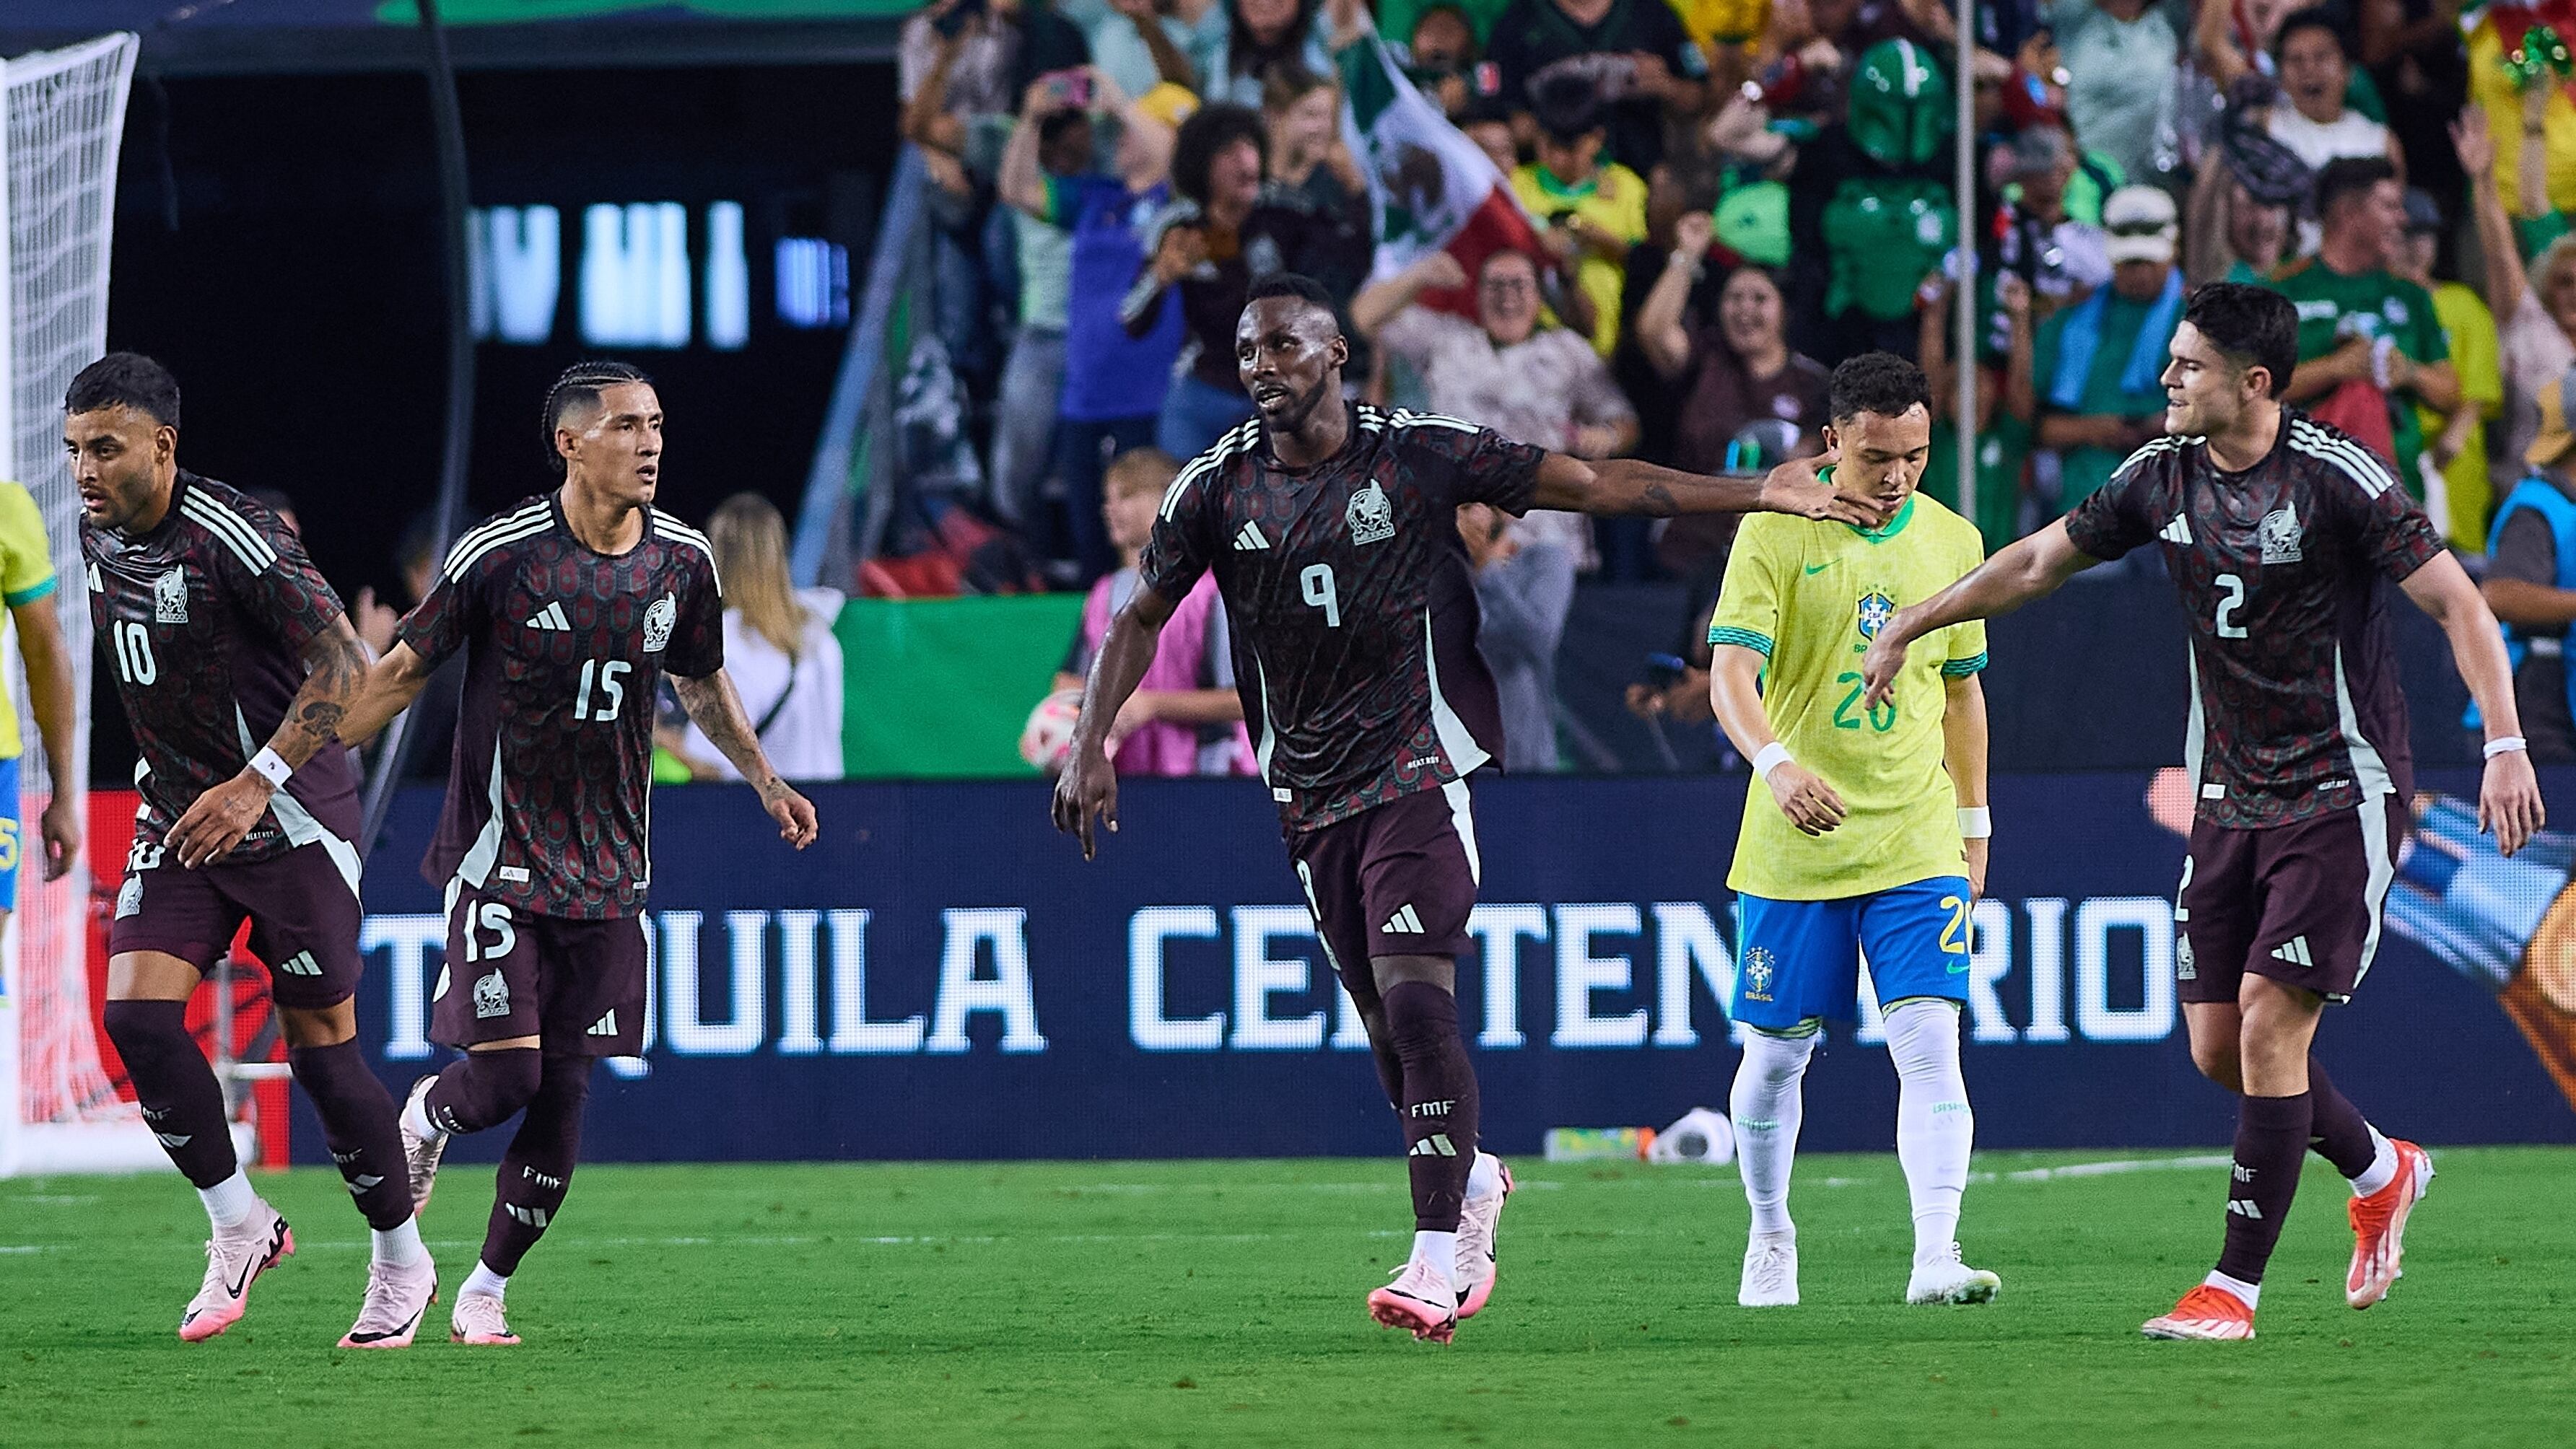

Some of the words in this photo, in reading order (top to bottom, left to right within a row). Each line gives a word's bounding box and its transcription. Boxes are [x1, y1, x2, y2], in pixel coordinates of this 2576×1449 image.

[1300, 563, 1340, 627] 9
[2214, 574, 2248, 638] 2
[114, 619, 157, 686] 10
[575, 659, 632, 721] 15
[464, 899, 515, 963] 15
[358, 906, 1049, 1078] TUILA
[1127, 896, 2178, 1053] CETENRIO
[142, 1106, 172, 1120] MF
[1411, 1100, 1456, 1118] FMF
[2233, 1160, 2258, 1183] MF
